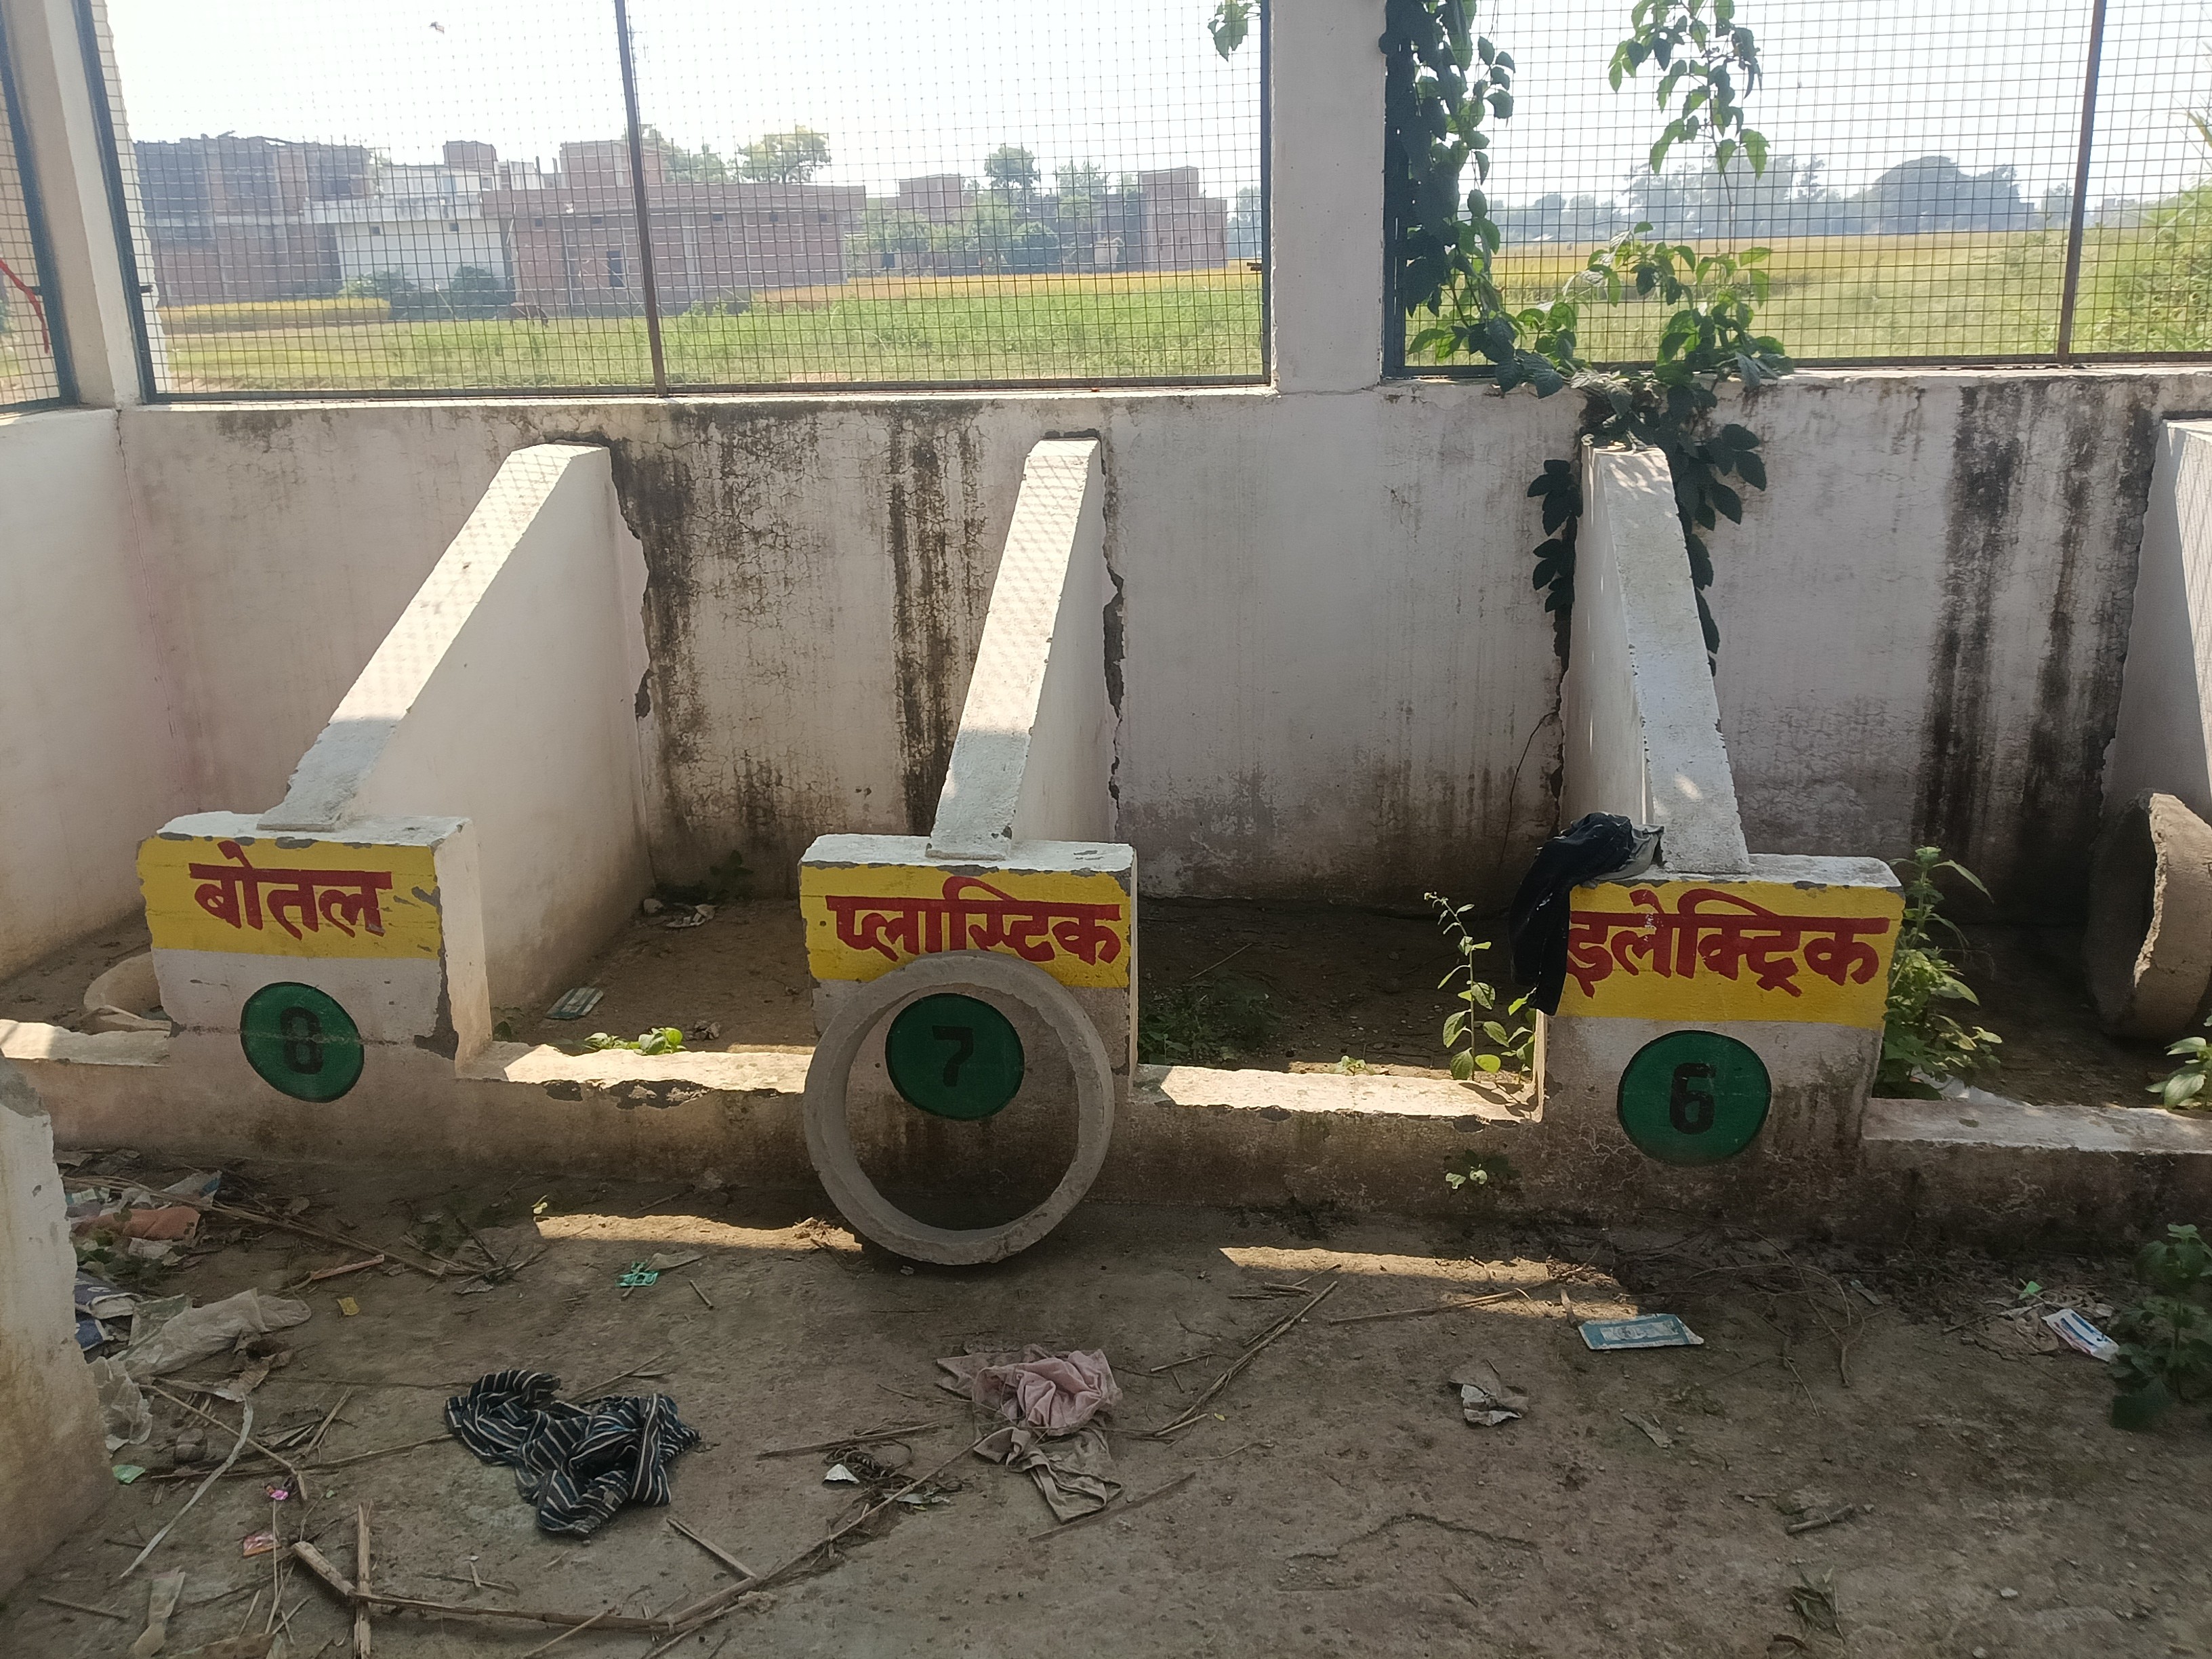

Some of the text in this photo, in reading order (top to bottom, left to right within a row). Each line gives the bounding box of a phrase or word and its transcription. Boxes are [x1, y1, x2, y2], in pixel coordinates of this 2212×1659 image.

[188, 841, 393, 941] बोतल
[825, 876, 1122, 966] प्लास्टिक
[1566, 888, 1890, 999] इलेक्ट्रिक
[279, 1006, 324, 1075] 8
[932, 1025, 974, 1087] 7
[1669, 1063, 1716, 1135] 6
